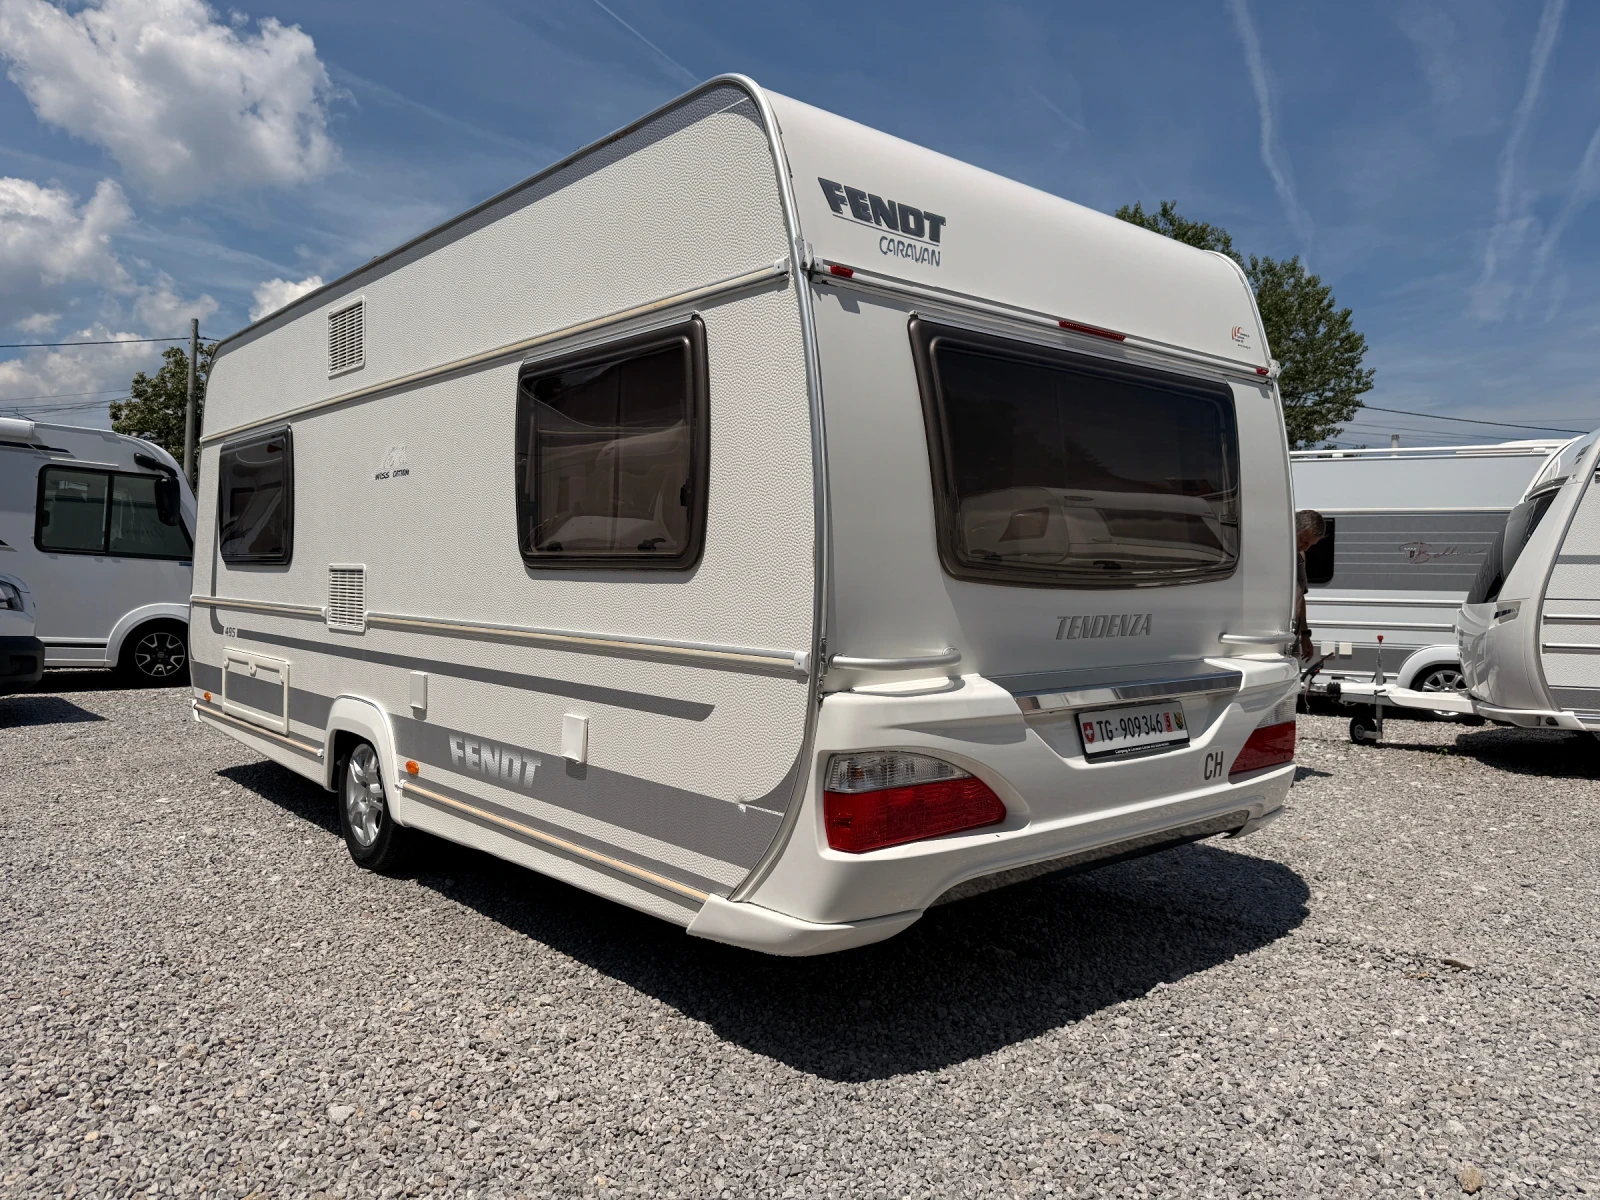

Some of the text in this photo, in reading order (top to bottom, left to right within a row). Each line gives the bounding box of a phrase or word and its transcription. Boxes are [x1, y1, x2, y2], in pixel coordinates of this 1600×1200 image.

[818, 177, 946, 243] FENDT
[879, 236, 941, 267] CARAVAN
[224, 626, 236, 638] 495
[1055, 613, 1153, 640] TENDENZA
[448, 733, 542, 789] FENDT
[1203, 751, 1224, 781] CH
